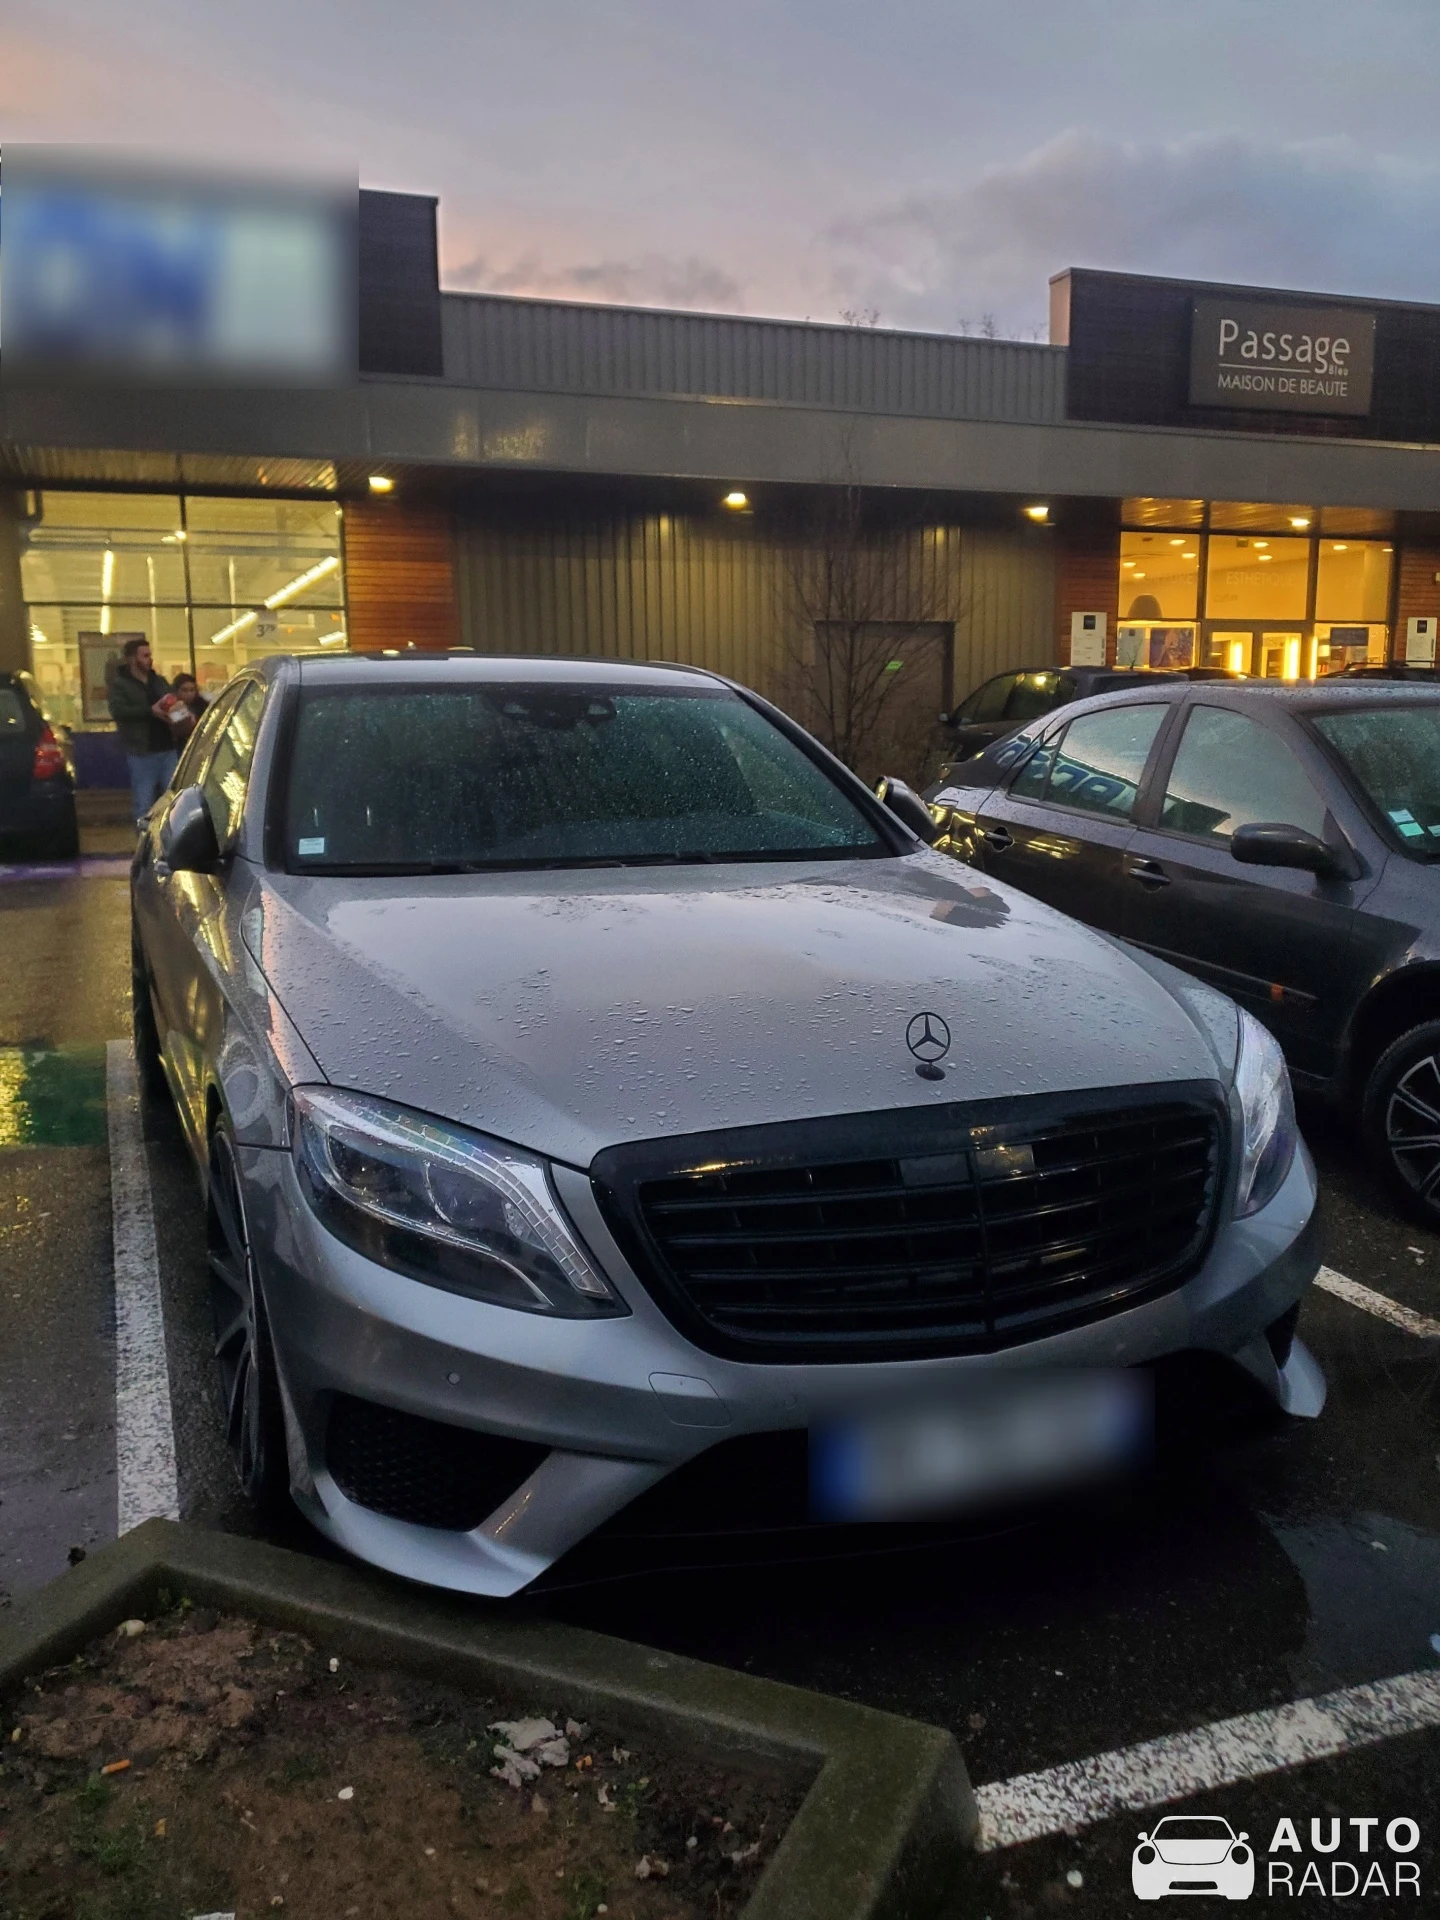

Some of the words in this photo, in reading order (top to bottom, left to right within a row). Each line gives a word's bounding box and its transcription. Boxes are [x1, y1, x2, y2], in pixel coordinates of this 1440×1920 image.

[1218, 319, 1350, 374] Passage
[1218, 374, 1275, 391] MAISON
[1279, 378, 1297, 394] DE
[1300, 379, 1348, 397] BEAUTE
